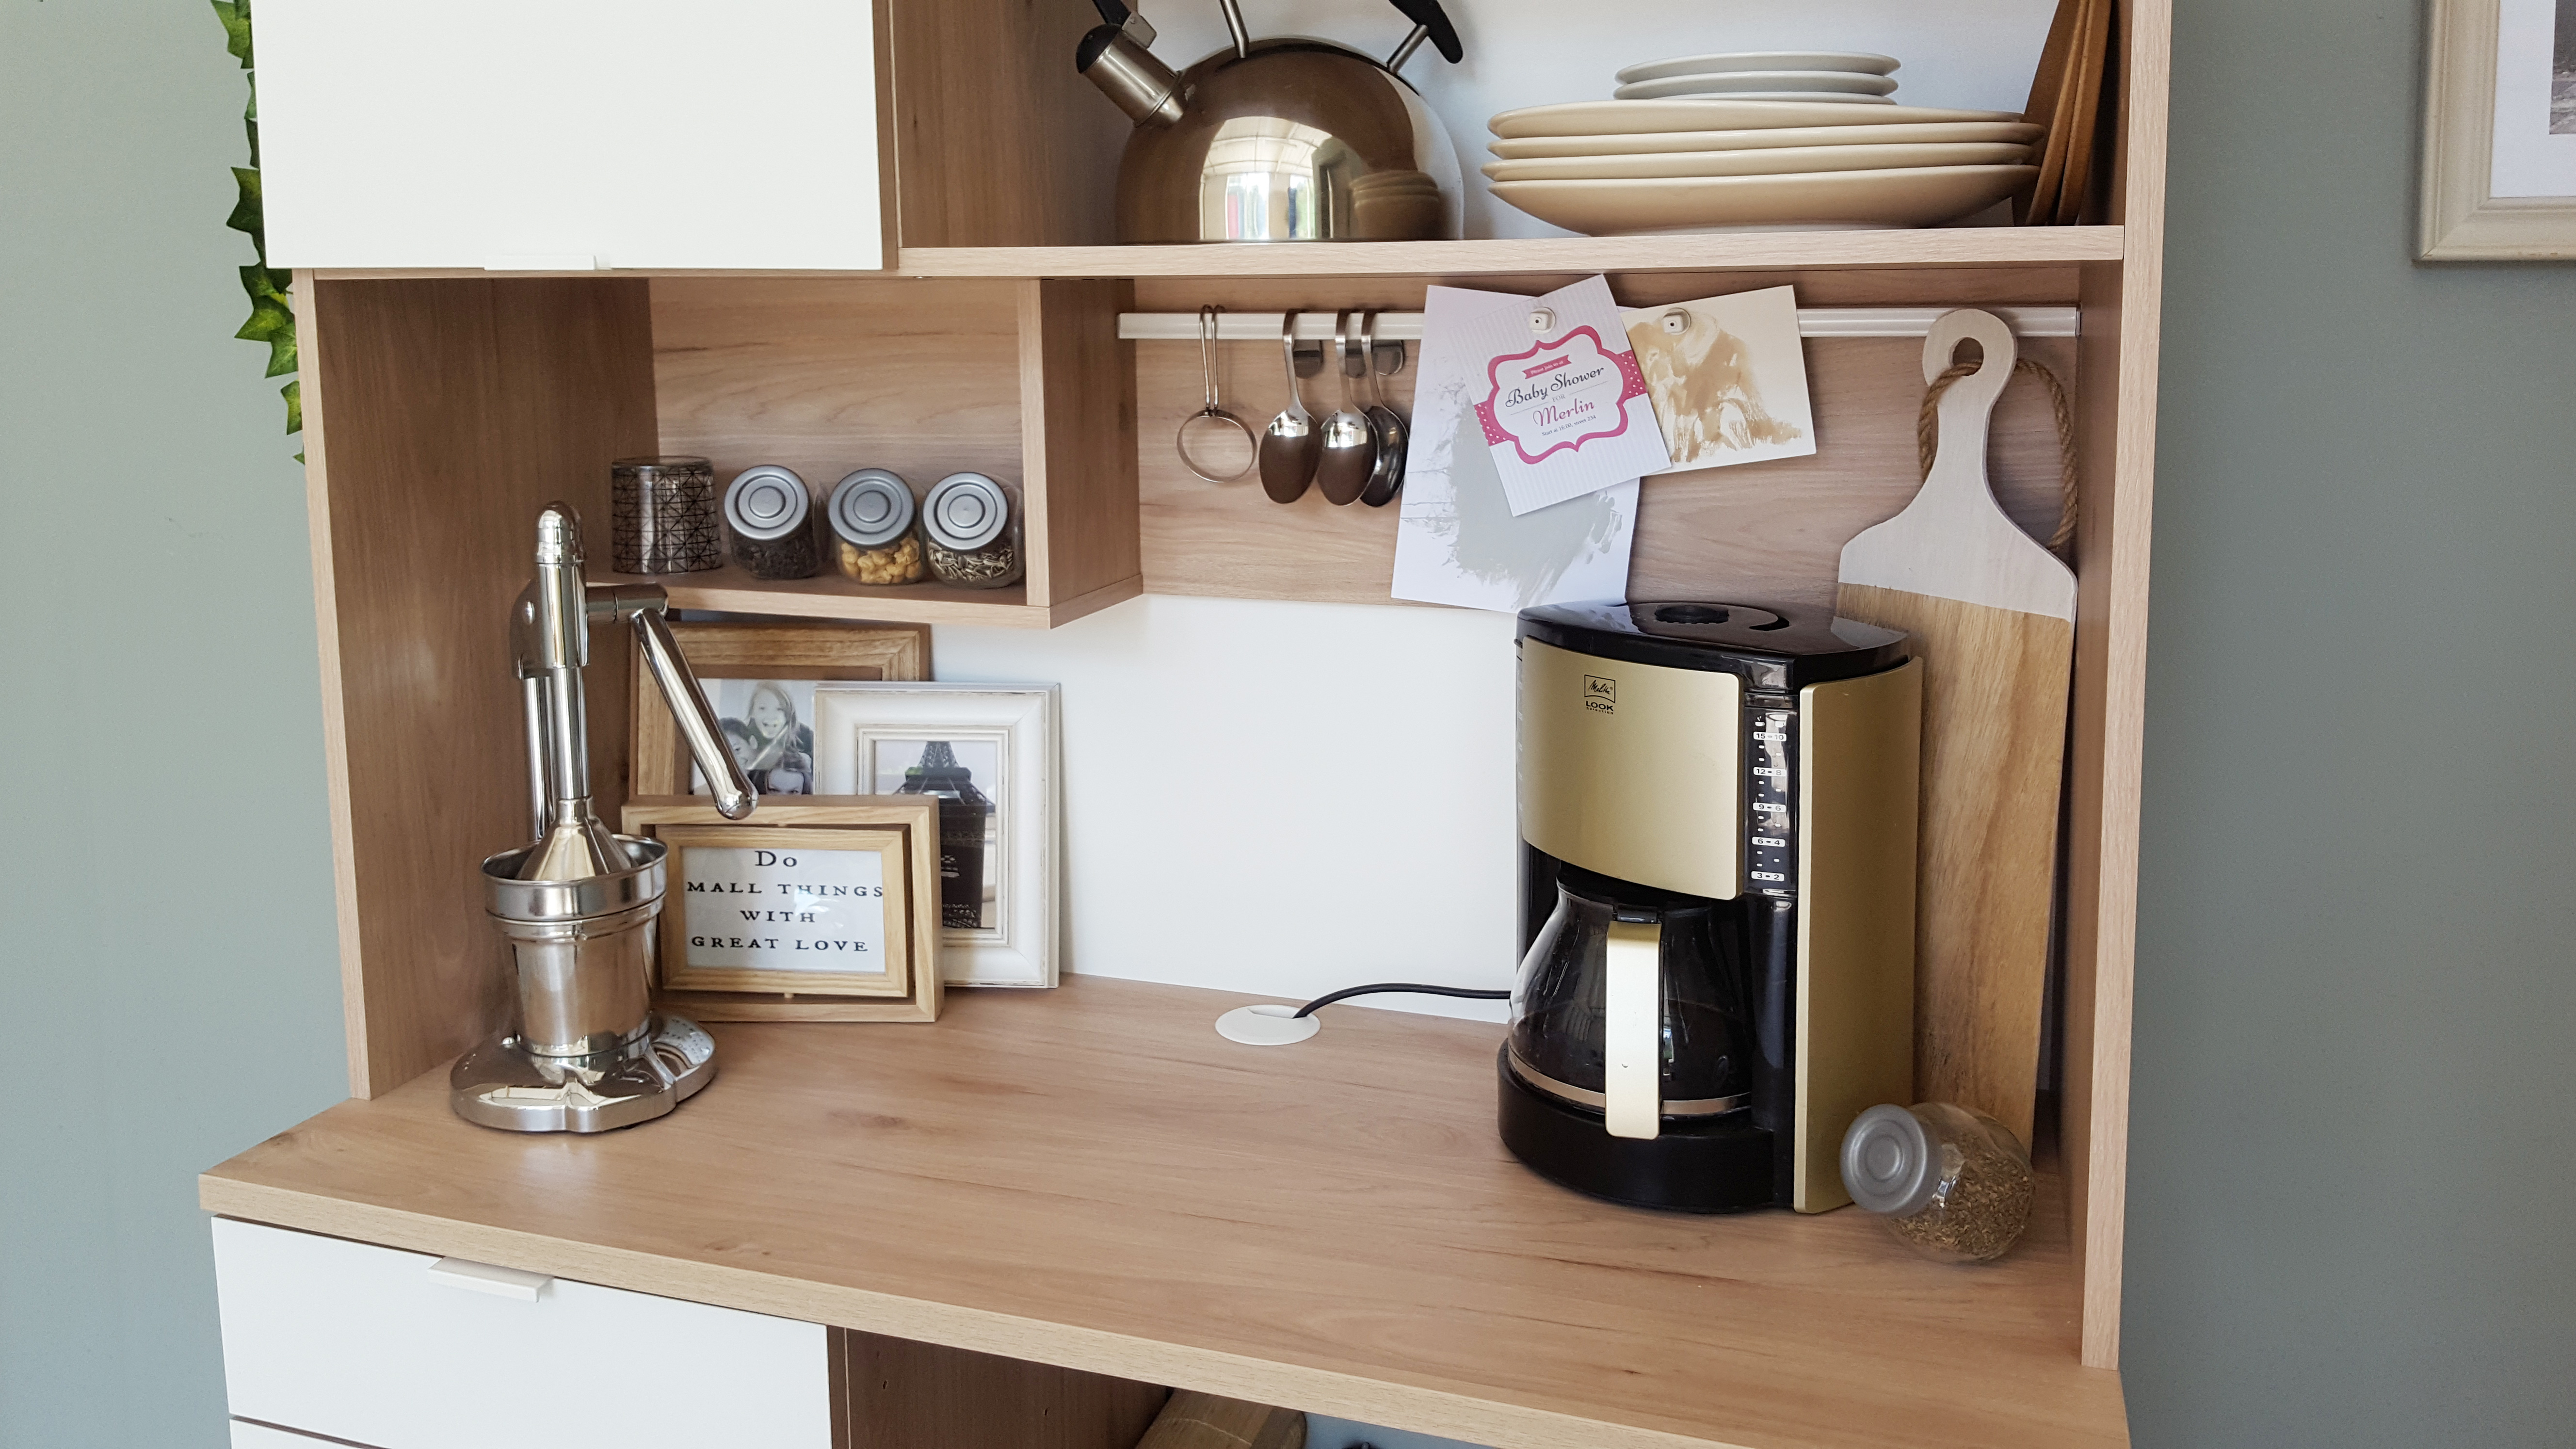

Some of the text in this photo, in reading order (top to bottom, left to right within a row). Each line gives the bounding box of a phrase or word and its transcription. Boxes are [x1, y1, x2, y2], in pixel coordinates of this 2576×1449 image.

[1505, 367, 1604, 407] Baby Shower
[1532, 398, 1594, 426] Merlin
[1588, 679, 1611, 694] Melitta
[1586, 700, 1614, 711] LOOK
[755, 850, 798, 867] Do
[687, 881, 883, 897] MALL THINGS
[740, 910, 816, 923] WITH
[691, 936, 868, 952] GREAT LOVE
